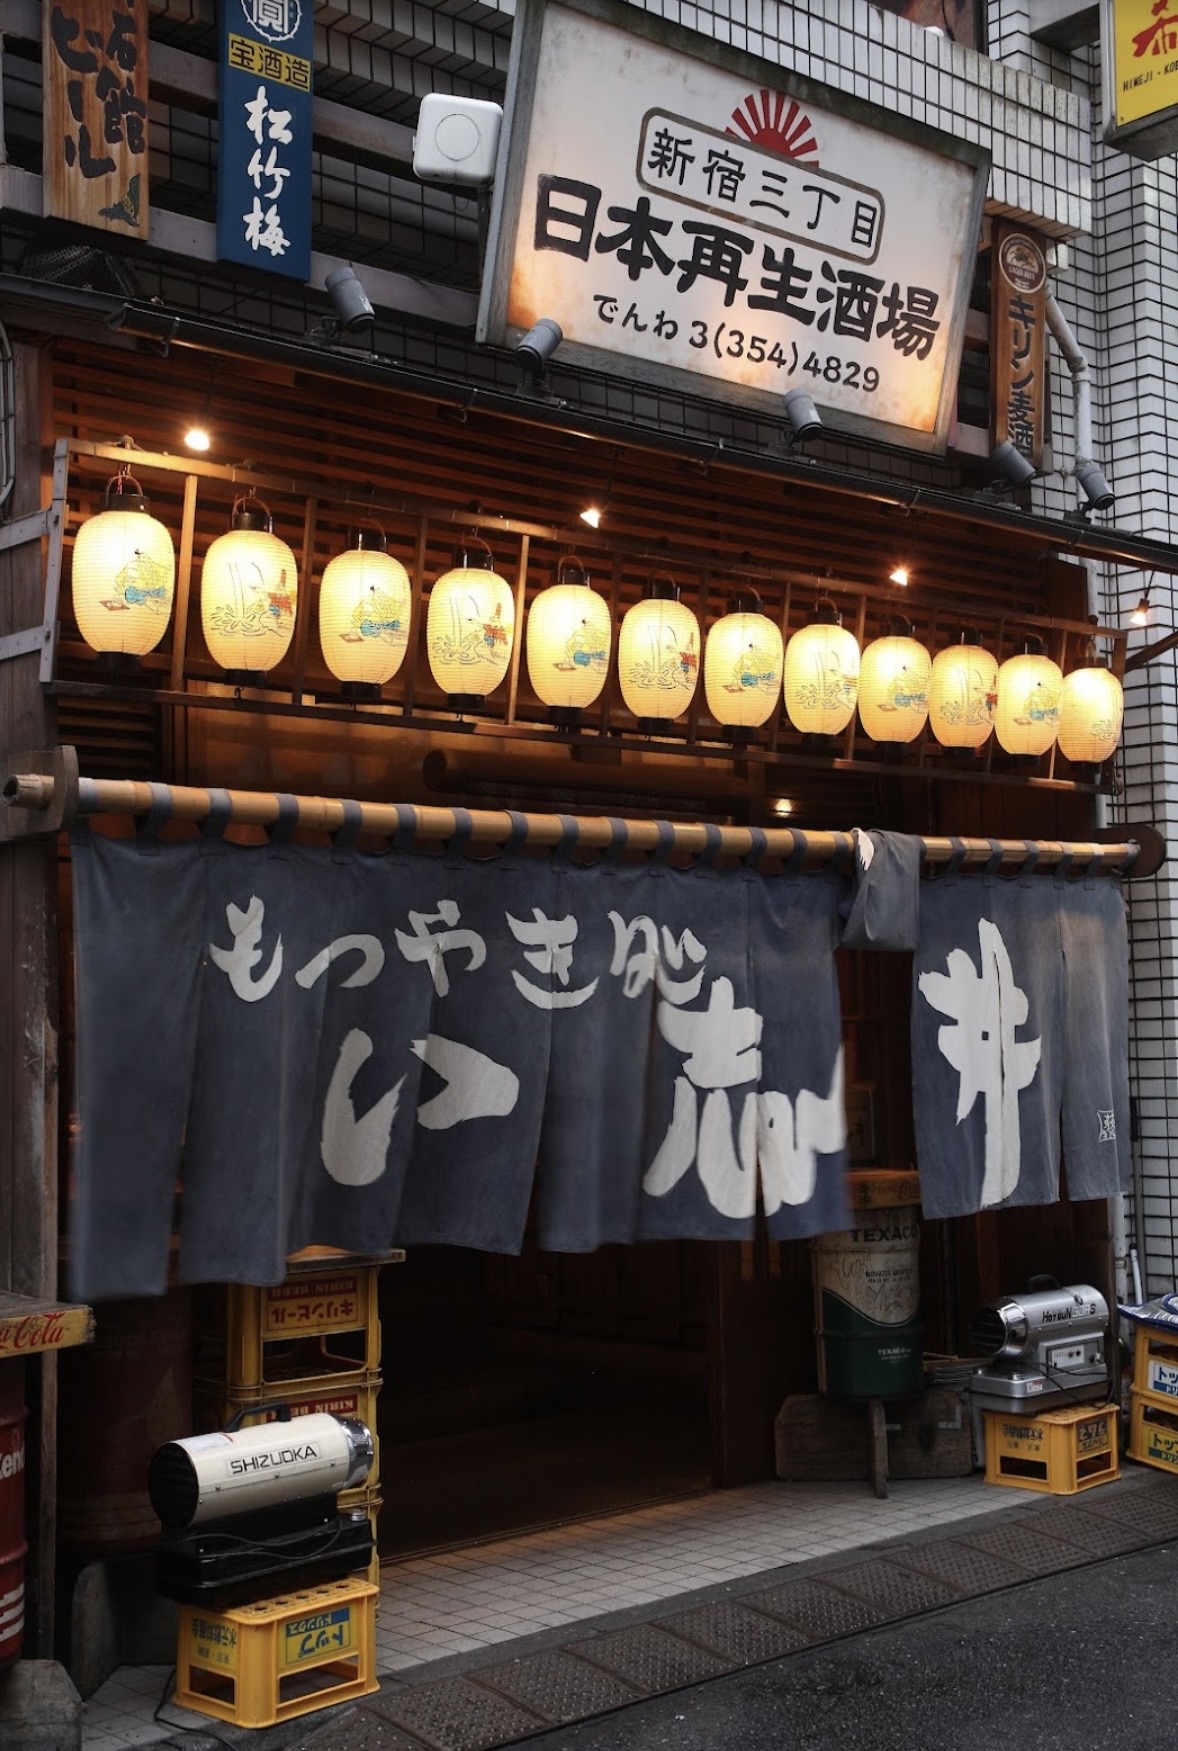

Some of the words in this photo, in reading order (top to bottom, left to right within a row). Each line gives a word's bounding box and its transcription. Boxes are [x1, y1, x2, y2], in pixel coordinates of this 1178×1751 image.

[230, 39, 309, 90] 宝酒造
[1123, 70, 1153, 92] HIMEJI
[243, 86, 293, 256] 松竹梅
[647, 127, 878, 248] 新宿三丁目
[534, 173, 941, 360] 日本再生酒場
[593, 294, 679, 340] でんわ
[688, 321, 880, 393] 3(354)4829
[849, 1223, 919, 1243] TEXACO
[272, 1299, 354, 1324] キリンビール
[230, 1443, 317, 1475] SHIZUOKA
[288, 1613, 332, 1635] ドリンクス
[297, 1624, 343, 1659] トップ
